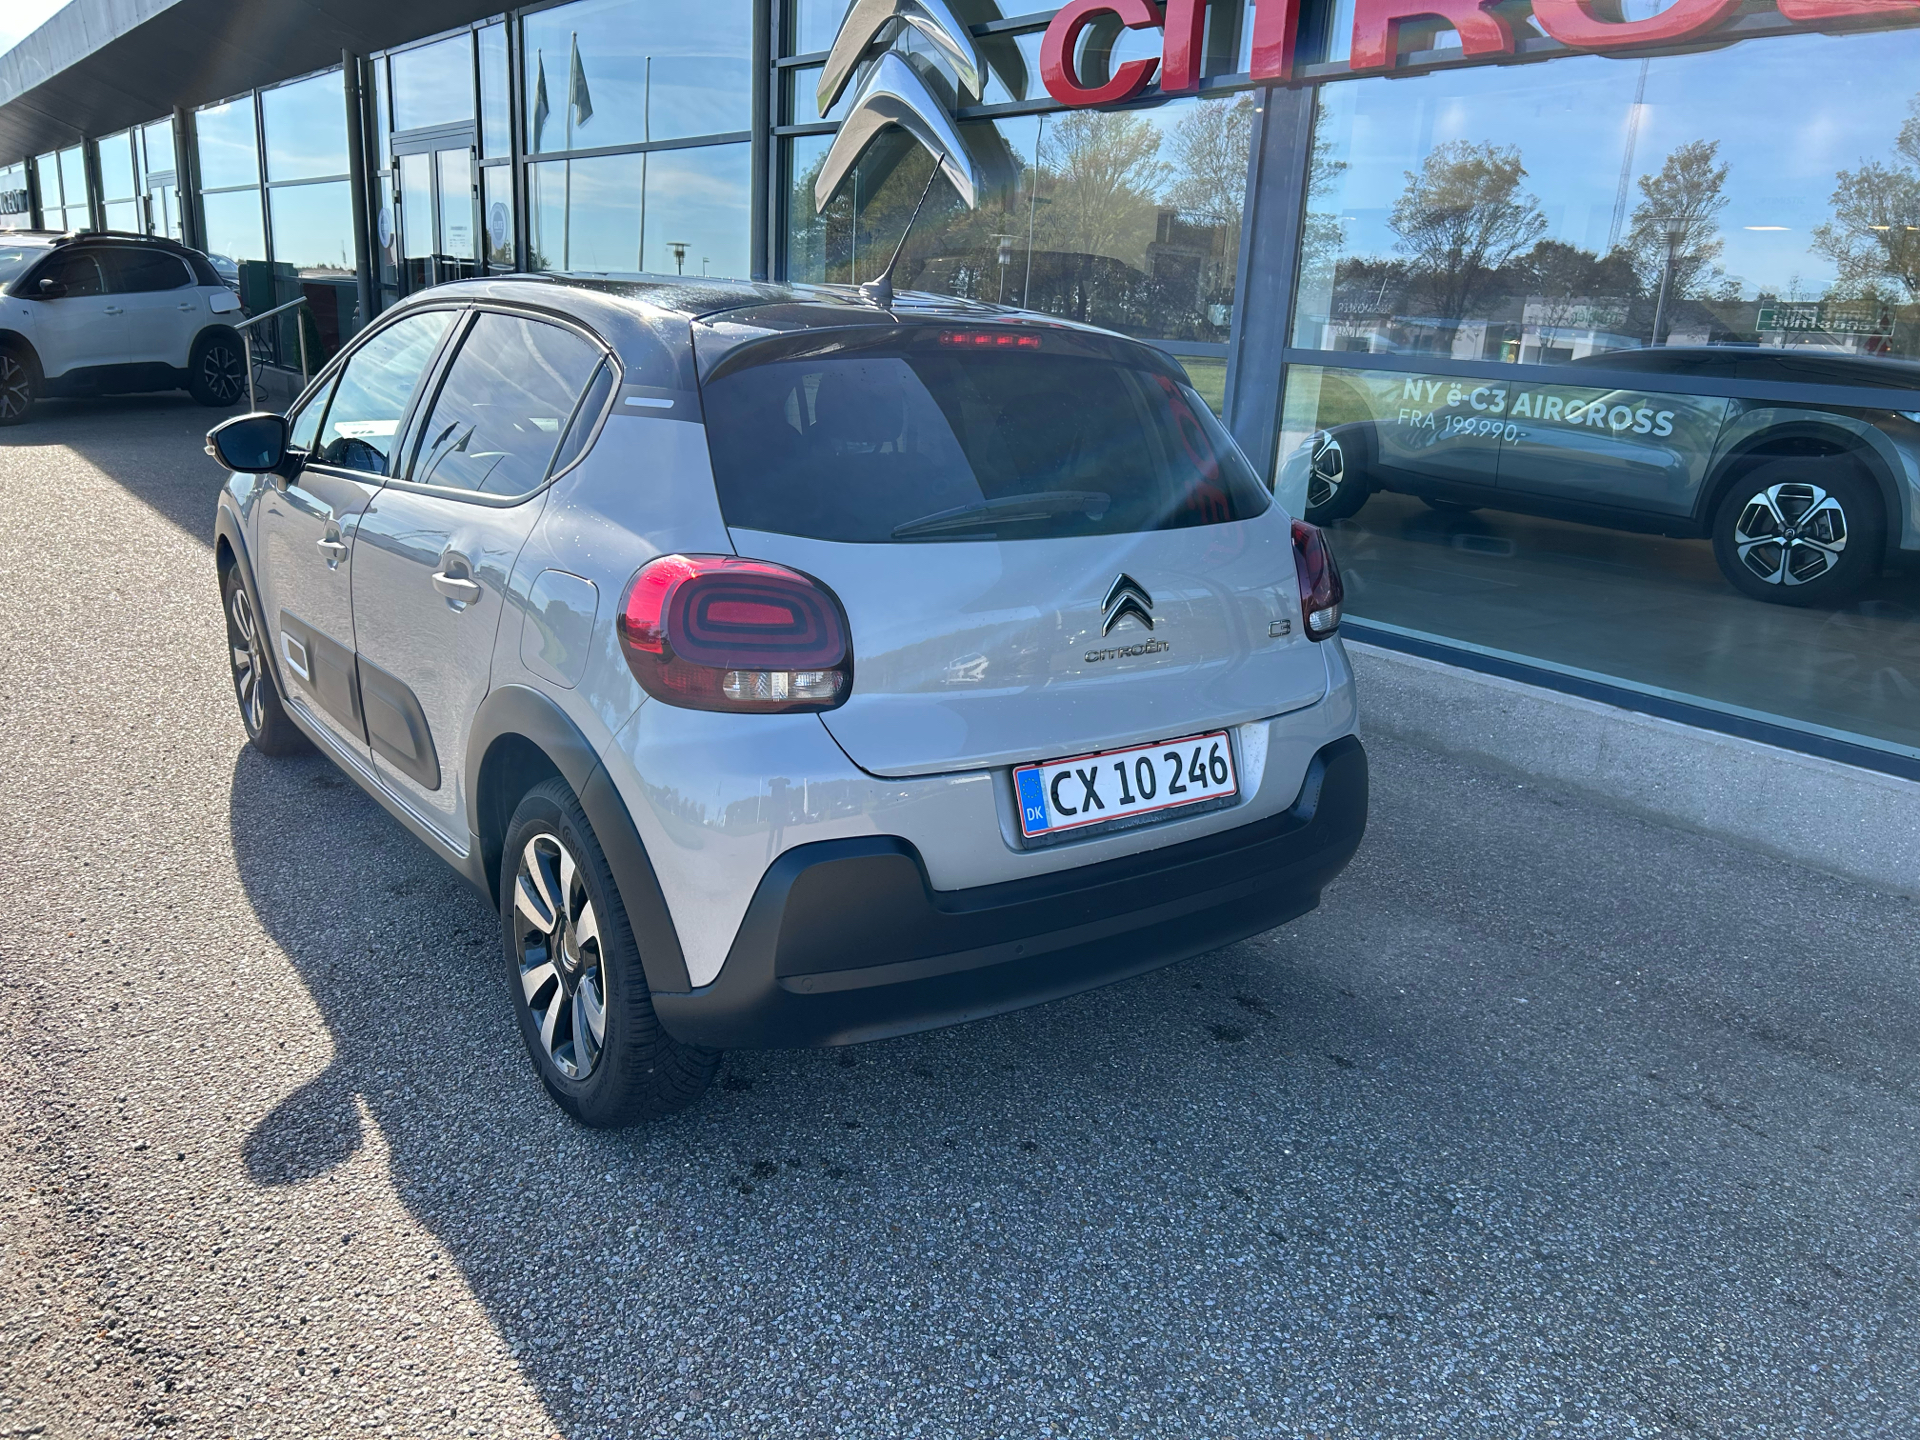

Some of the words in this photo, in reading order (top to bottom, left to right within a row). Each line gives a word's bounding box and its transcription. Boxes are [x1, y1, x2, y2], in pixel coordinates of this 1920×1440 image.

[1402, 378, 1443, 403] NY
[1446, 383, 1506, 413] ë-C3
[1510, 392, 1675, 437] AIRCROSS
[1397, 408, 1436, 430] FRA
[1268, 619, 1292, 638] C3
[1050, 766, 1105, 816] CX
[1113, 756, 1157, 806] 10
[1163, 741, 1228, 796] 246
[1026, 805, 1044, 822] DK
